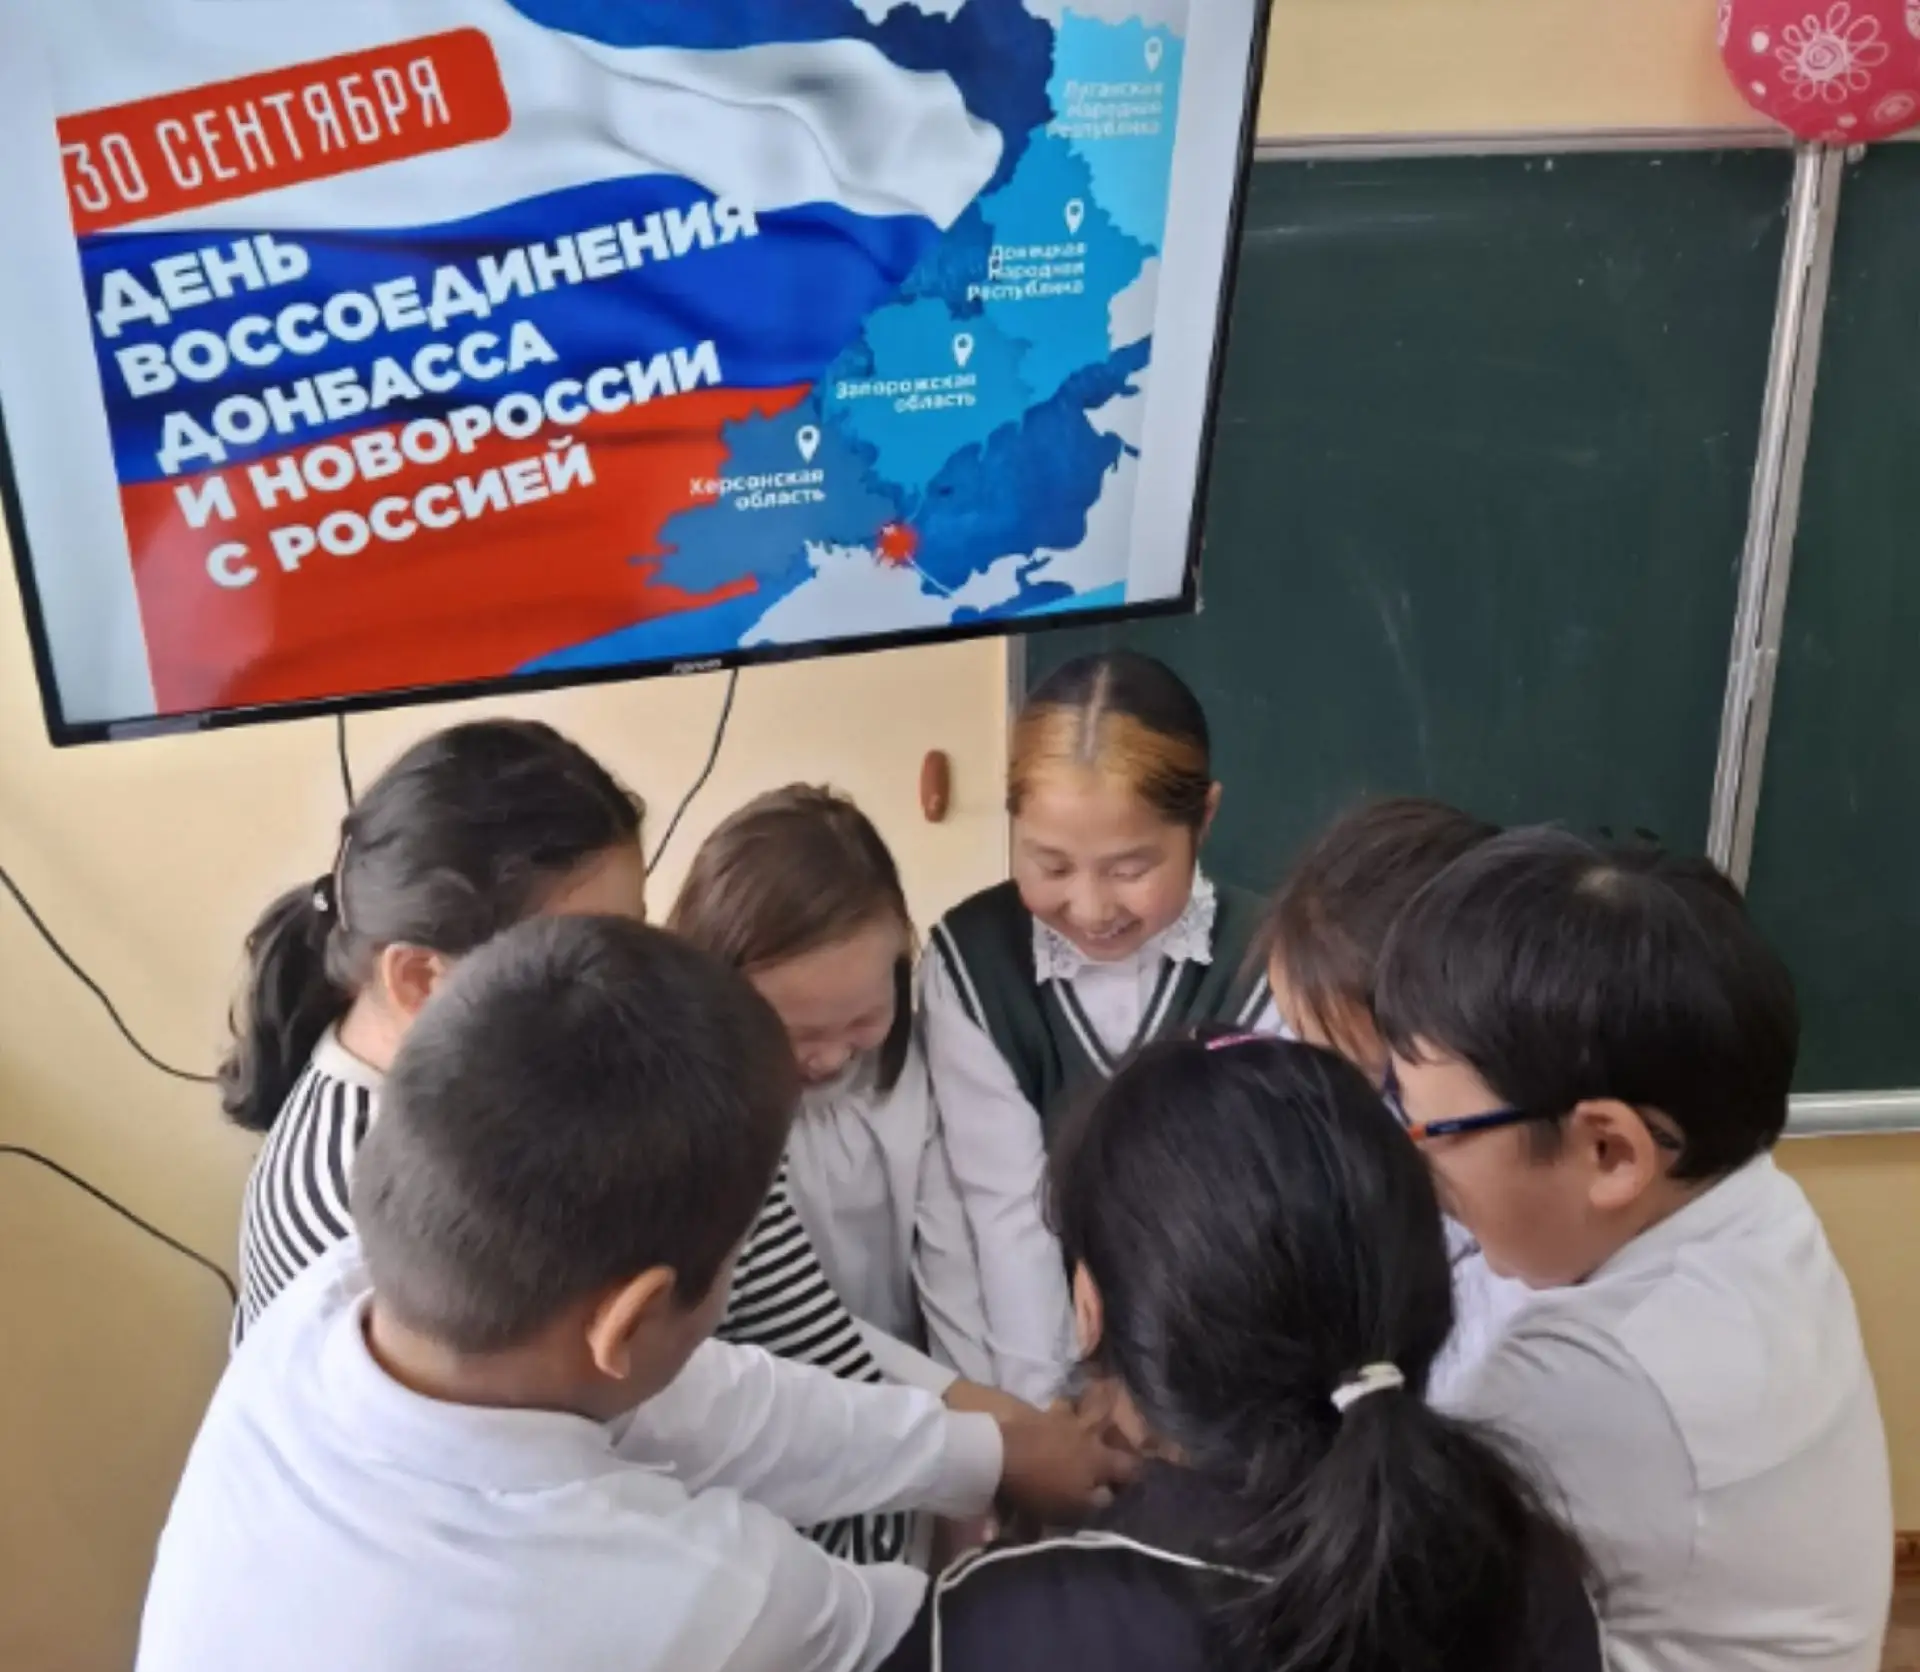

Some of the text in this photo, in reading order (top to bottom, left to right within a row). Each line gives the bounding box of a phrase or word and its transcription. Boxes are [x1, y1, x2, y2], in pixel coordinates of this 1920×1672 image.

[61, 56, 451, 213] 30 СЕНТЯБРЯ
[96, 234, 311, 338] ДЕНЬ
[114, 198, 760, 398] ВОССОЕДИНЕНИЯ
[155, 321, 558, 474] ДОНБАССА
[174, 341, 723, 529] И НОВОРОССИИ
[836, 373, 976, 399] Запорожская
[894, 392, 976, 413] область
[206, 442, 595, 589] С РОССИЕЙ
[689, 468, 824, 497] Херсонская
[734, 489, 826, 511] область
